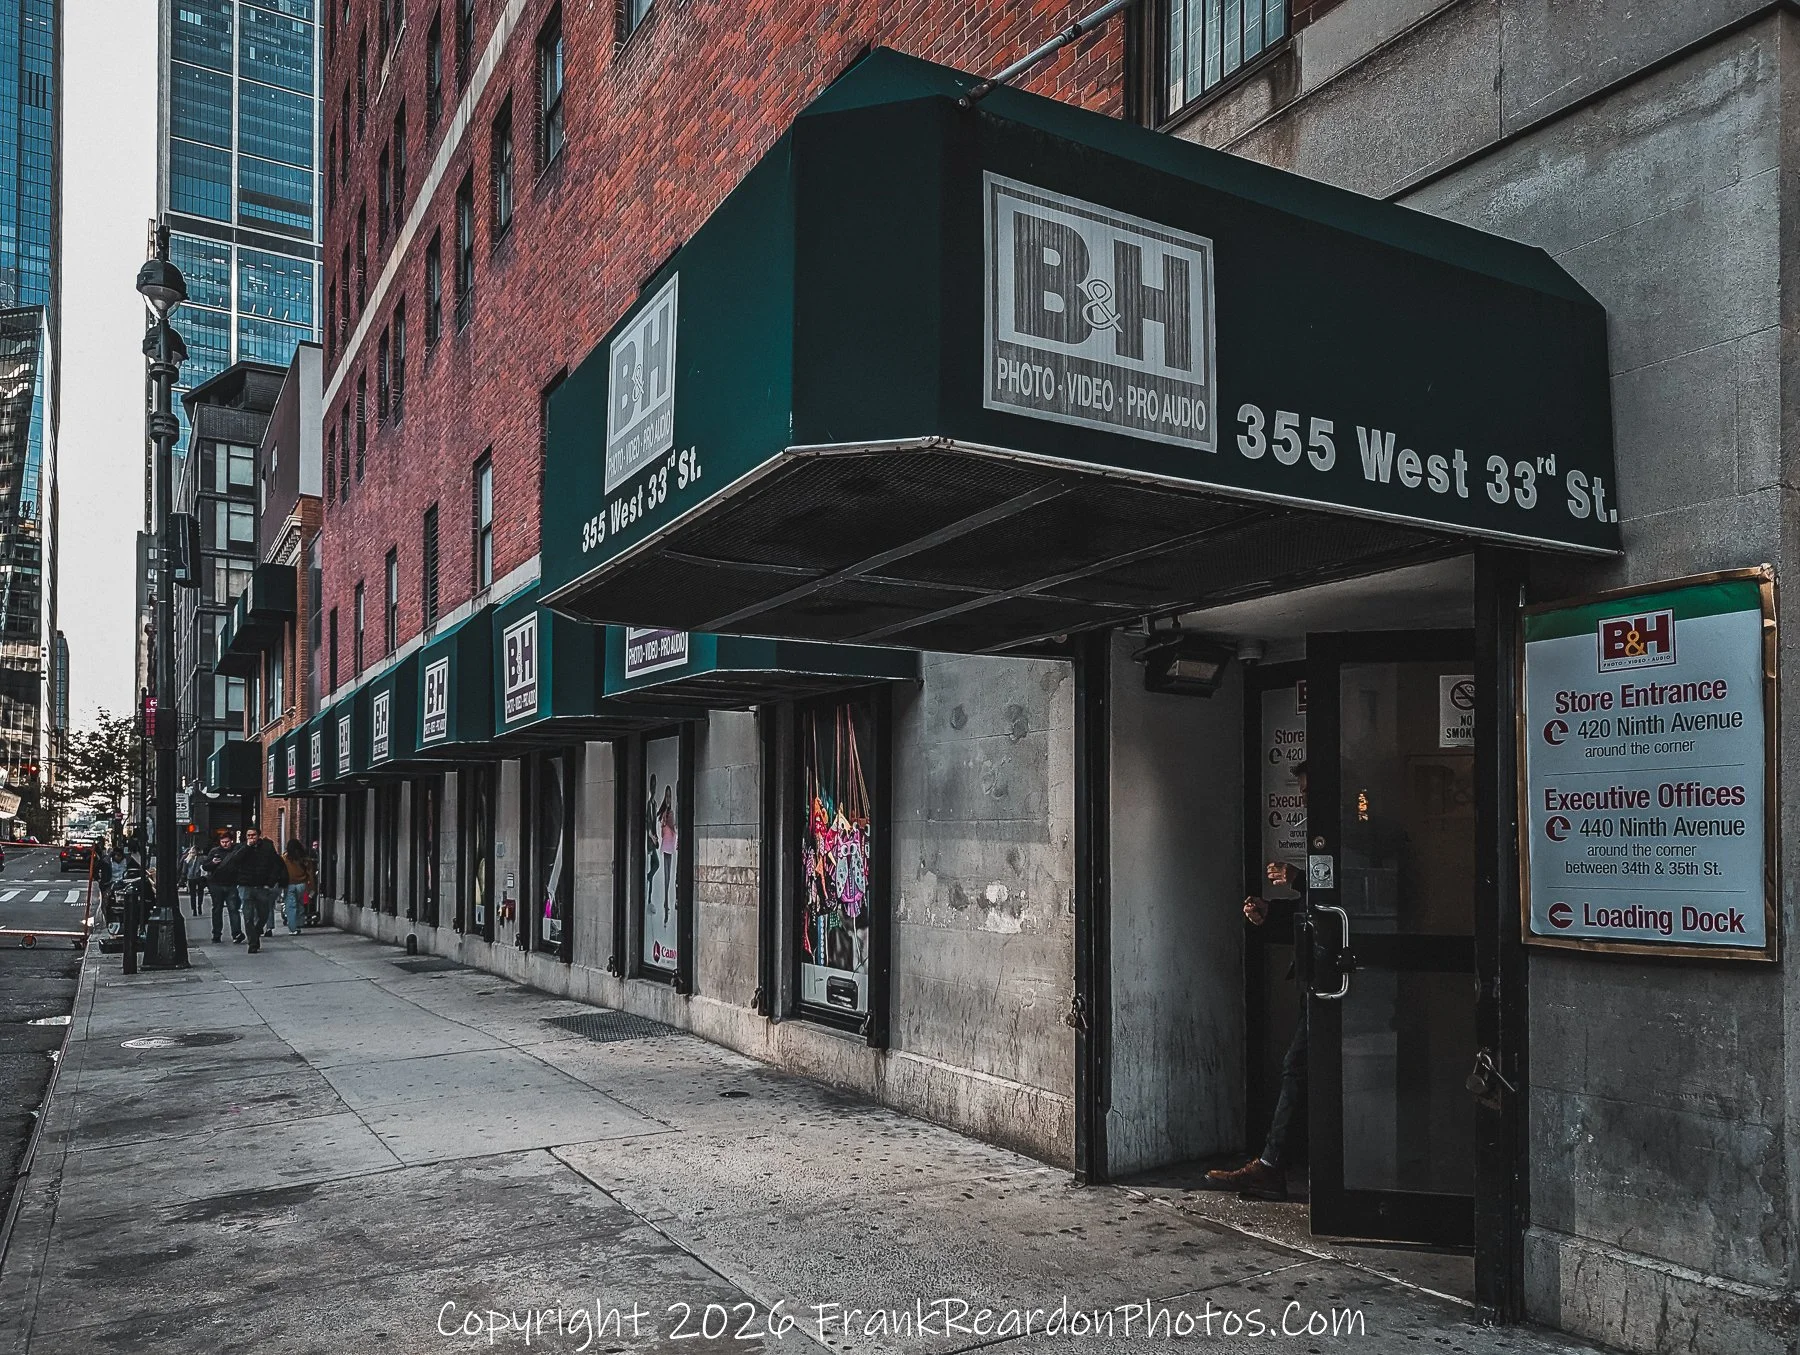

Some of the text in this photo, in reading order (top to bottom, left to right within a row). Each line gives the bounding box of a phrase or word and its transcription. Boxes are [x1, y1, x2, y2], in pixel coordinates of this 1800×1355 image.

[1013, 210, 1192, 372] B&H
[613, 301, 669, 436] B&H
[997, 358, 1207, 432] PHOTO VIDEO PRO AUDIO
[608, 448, 624, 479] PHOTO
[626, 435, 640, 465] VIDEO
[1237, 404, 1619, 524] 355 West 33rd St.
[582, 446, 702, 553] 355 West 33rd St.
[1603, 614, 1670, 660] B&H
[507, 626, 534, 688] B&H
[628, 644, 644, 666] PHOTO
[645, 640, 658, 661] VIDEO
[1555, 678, 1727, 714] Store Entrance
[375, 699, 388, 738] BH
[1460, 715, 1473, 726] NO
[1577, 710, 1743, 740] 420 Ninth Avenue
[340, 722, 349, 754] BH
[1275, 729, 1305, 744] Store
[1446, 728, 1474, 738] SMOK
[1286, 748, 1303, 761] 420
[1585, 738, 1695, 758] around the corner
[1269, 793, 1305, 808] Execu
[1545, 782, 1745, 811] Executive Offices
[1286, 812, 1304, 826] 440
[1579, 816, 1745, 838] 440 Ninth Avenue
[1279, 840, 1305, 849] between
[1289, 830, 1307, 838] aroun
[1587, 843, 1697, 858] around the corner
[1565, 861, 1723, 876] between 34th & 35th St.
[1584, 903, 1745, 934] Loading Dock
[661, 946, 677, 959] Cano
